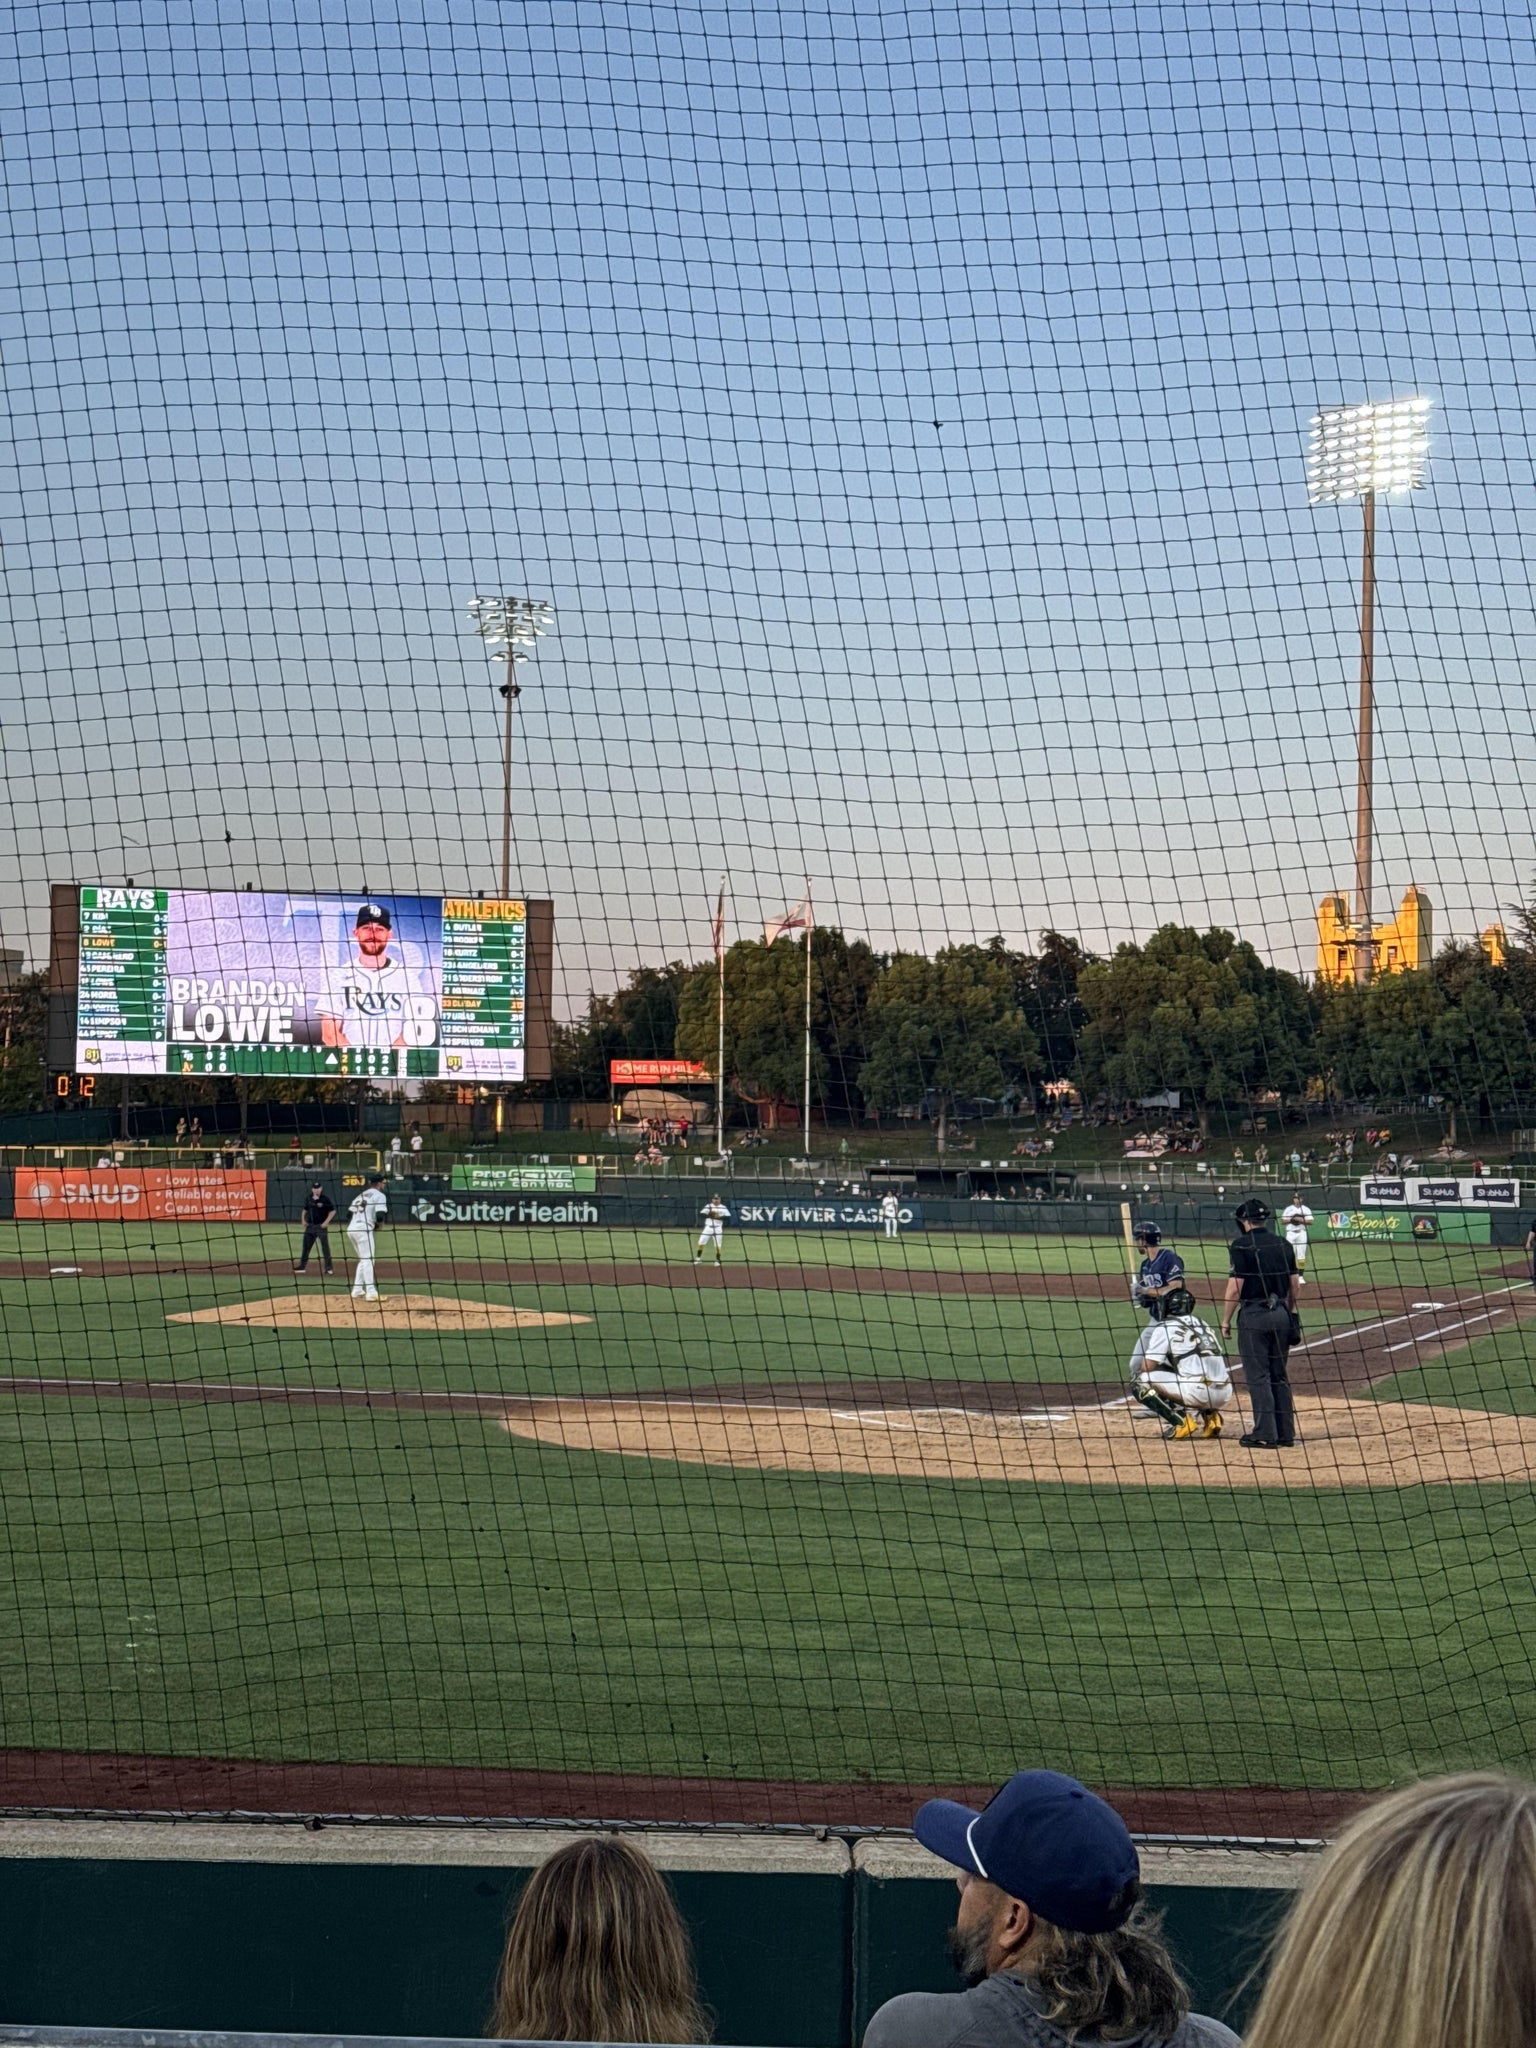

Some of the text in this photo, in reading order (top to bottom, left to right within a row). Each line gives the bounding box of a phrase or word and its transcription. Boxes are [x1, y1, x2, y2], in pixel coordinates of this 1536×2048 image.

[96, 888, 155, 909] RAYS
[444, 901, 526, 920] ATHLETICS
[172, 978, 304, 1006] BRANDON
[342, 986, 401, 1015] RAYS
[171, 1005, 293, 1042] LOWE
[403, 997, 436, 1046] 8
[220, 1052, 226, 1060] 2
[342, 1054, 348, 1063] 2
[382, 1055, 389, 1064] 2
[650, 1064, 670, 1073] RUN
[673, 1064, 693, 1073] HILL
[165, 1175, 223, 1186] Low rates
[59, 1183, 140, 1204] SMUD
[165, 1189, 254, 1200] Reliable service
[165, 1203, 242, 1216] Clean energy
[439, 1200, 597, 1222] Sutter Health
[740, 1206, 913, 1223] SKY RIVER CASIO
[1350, 1213, 1400, 1230] Sports
[1331, 1230, 1394, 1239] CALIFORNIA
